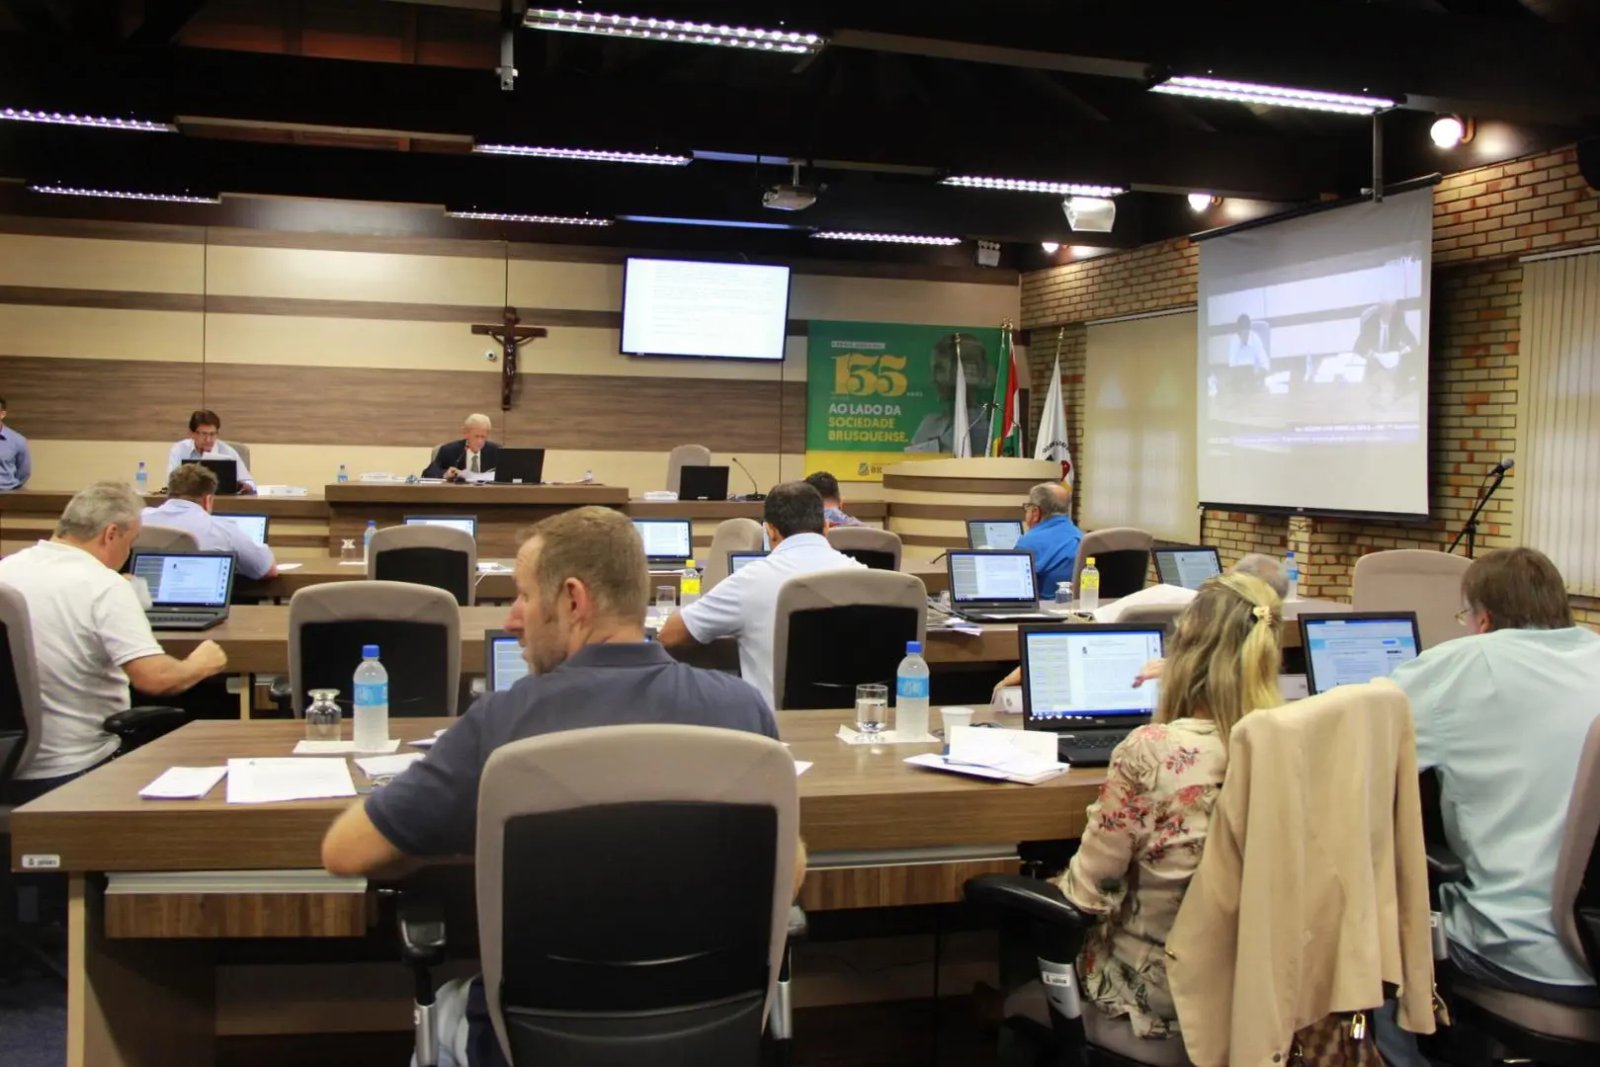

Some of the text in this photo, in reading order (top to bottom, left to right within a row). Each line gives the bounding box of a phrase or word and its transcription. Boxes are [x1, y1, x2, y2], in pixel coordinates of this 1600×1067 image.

[829, 403, 901, 416] AO LADO DA
[828, 416, 896, 429] SOCIEDADE
